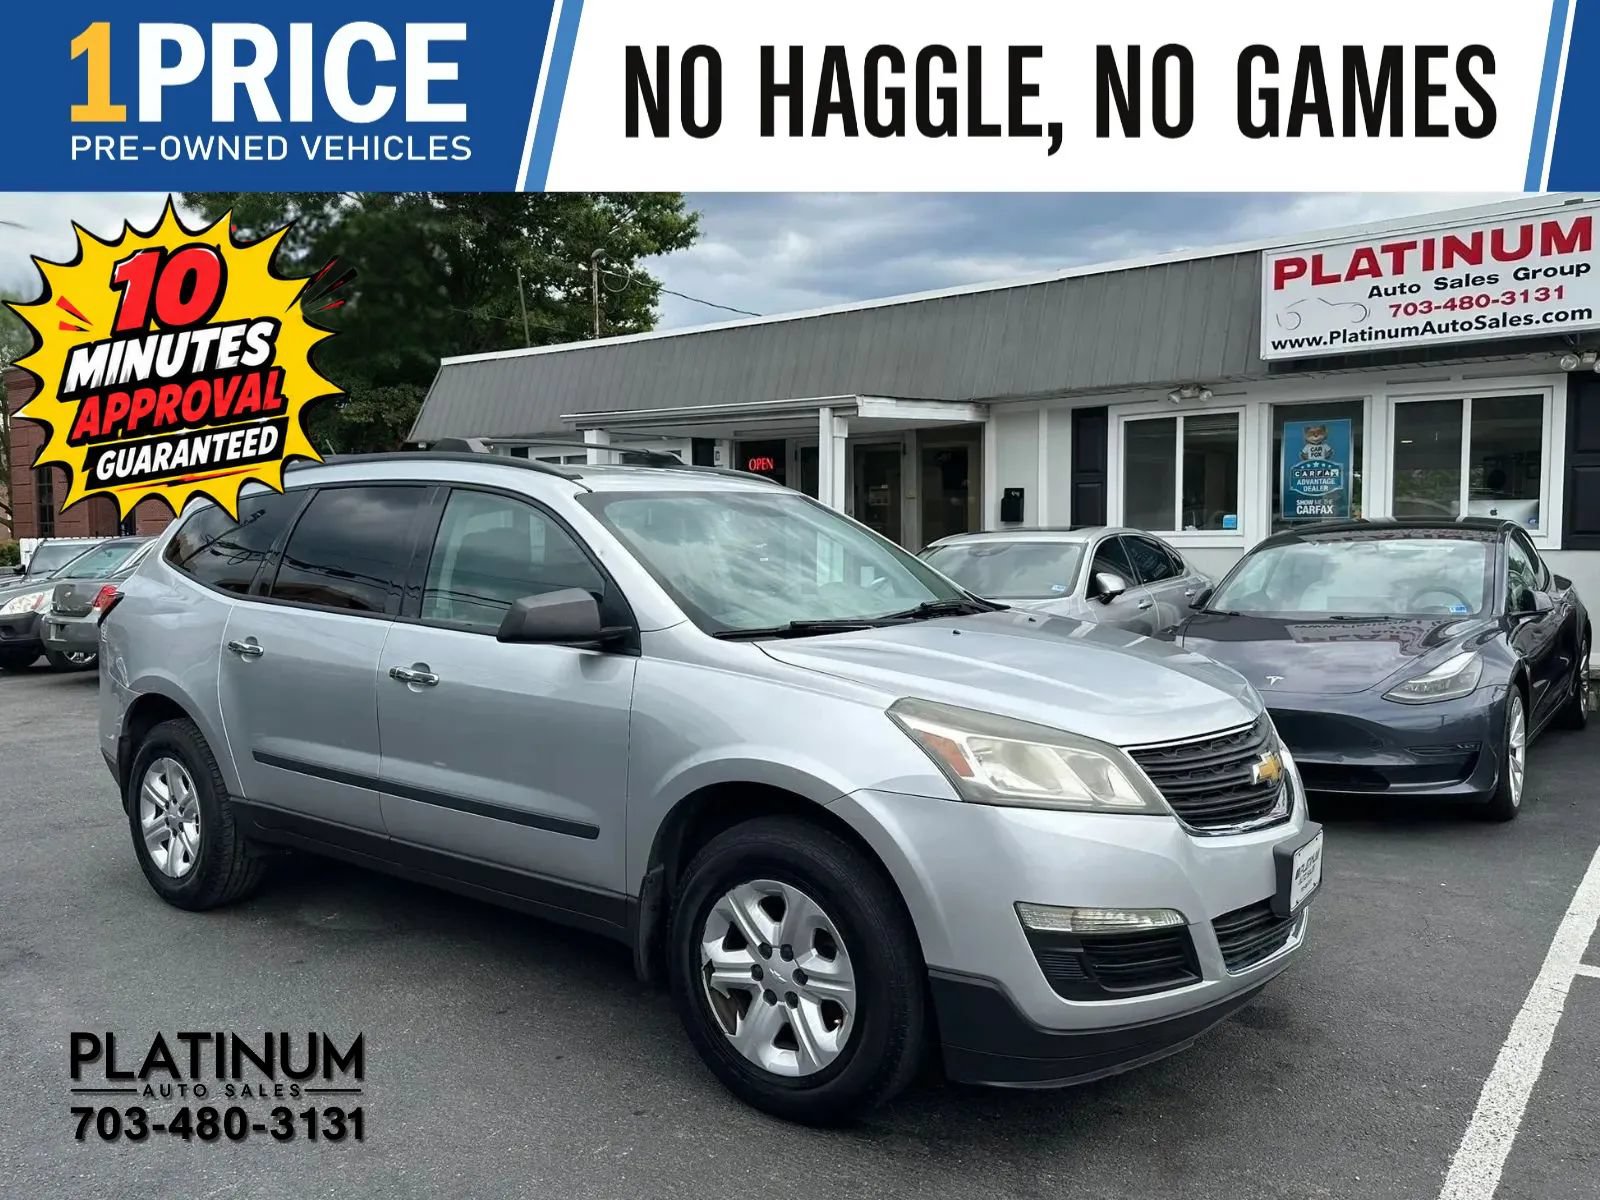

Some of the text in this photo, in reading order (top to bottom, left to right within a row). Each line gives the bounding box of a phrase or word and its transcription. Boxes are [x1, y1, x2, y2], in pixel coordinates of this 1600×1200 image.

[1273, 215, 1593, 291] PLATINUM
[1368, 262, 1592, 299] Auto Sales Group
[1389, 284, 1564, 318] 703-480-3131
[1271, 307, 1593, 351] www.PlatinumAutoSales.com
[748, 457, 774, 471] OPEN
[1294, 469, 1339, 477] CARFAX
[1296, 478, 1336, 486] ADVANTAGE
[1296, 505, 1334, 515] CARFAX
